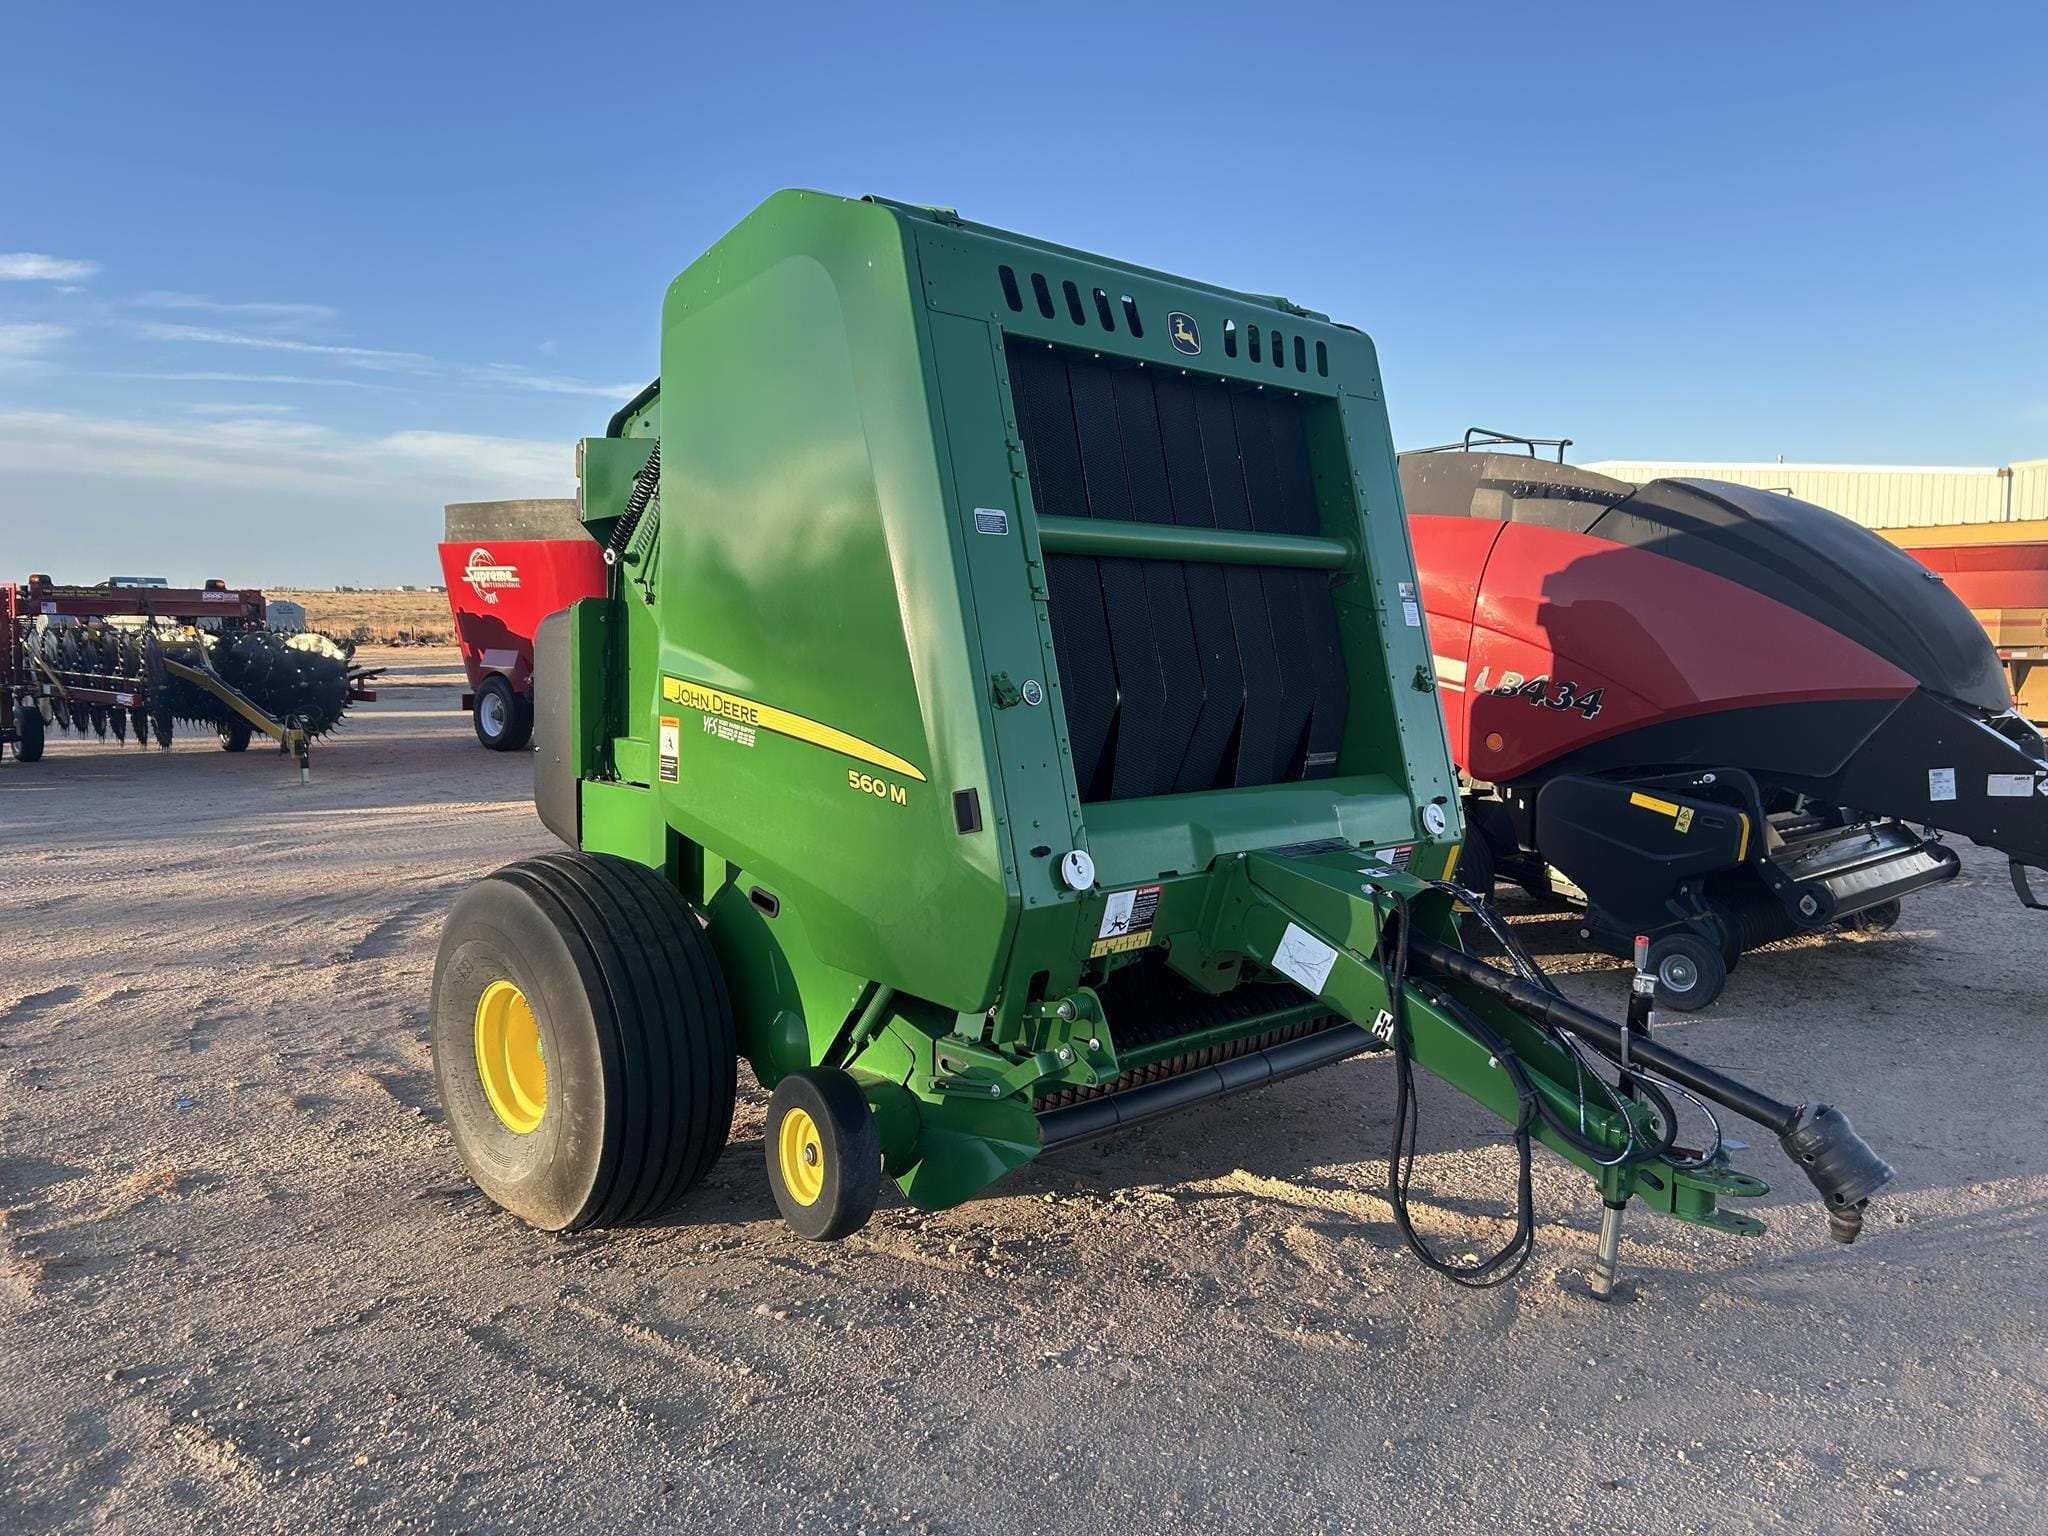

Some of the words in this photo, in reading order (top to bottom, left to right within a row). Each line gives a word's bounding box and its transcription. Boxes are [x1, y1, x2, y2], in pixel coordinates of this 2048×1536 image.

[461, 566, 520, 588] Supreme
[673, 684, 709, 708] JOHN
[712, 694, 758, 724] DEERE
[1473, 666, 1605, 720] LB434
[703, 715, 718, 735] YFS
[848, 768, 887, 799] 560
[889, 782, 908, 807] M
